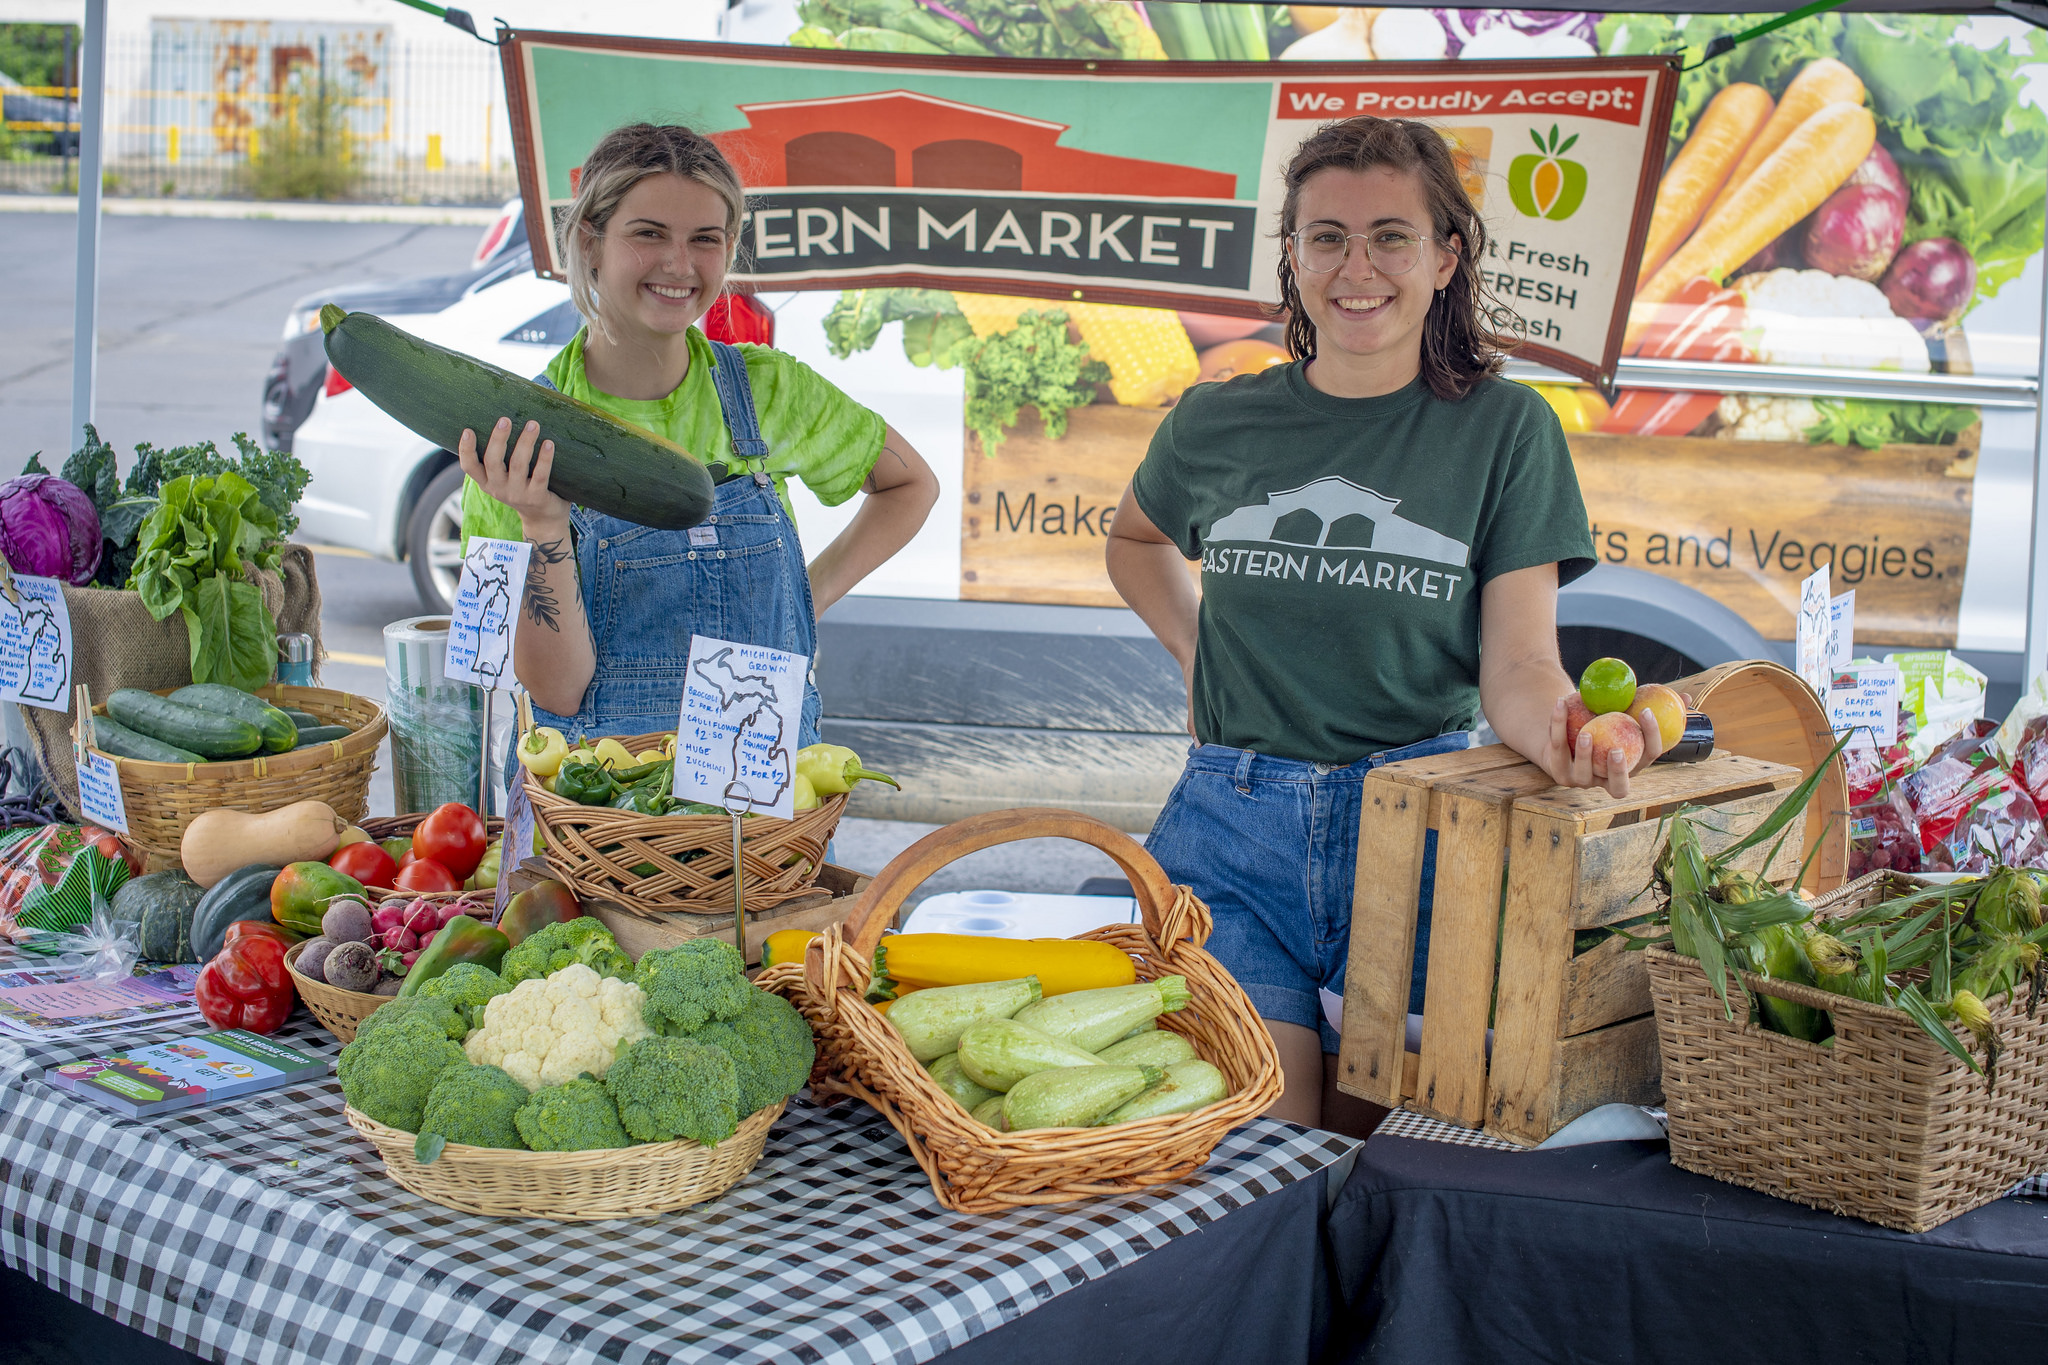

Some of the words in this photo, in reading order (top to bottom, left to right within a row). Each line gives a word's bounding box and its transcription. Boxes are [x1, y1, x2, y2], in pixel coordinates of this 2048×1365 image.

[1289, 92, 1345, 111] We
[1356, 91, 1493, 112] Proudly
[1500, 86, 1635, 111] Accept:
[742, 205, 891, 259] ERN
[917, 206, 1235, 270] MARKET
[1508, 241, 1590, 277] Fresh
[995, 491, 1118, 537] Make
[1645, 527, 1733, 569] and
[1749, 528, 1945, 585] Veggies.
[1201, 546, 1310, 582] EASTERN
[1316, 556, 1462, 602] MARKET
[17, 579, 57, 594] MICHIGAN
[740, 648, 791, 663] MICHIGAN
[0, 660, 25, 670] OMAINE
[748, 662, 787, 673] GROWN
[1858, 678, 1895, 687] CALIFORNIA
[688, 685, 718, 703] BROCCOLI
[688, 699, 695, 708] 2
[698, 702, 714, 712] FOR
[1845, 697, 1874, 707] GRAPES
[1834, 708, 1843, 719] $5
[685, 743, 711, 756] HUGE
[686, 756, 726, 774] ZUCCHINI
[694, 771, 708, 785] $2
[740, 765, 748, 776] 3
[751, 770, 769, 779] FOR
[771, 768, 784, 785] $2
[148, 1049, 170, 1058] BUY
[195, 1068, 219, 1076] GET
